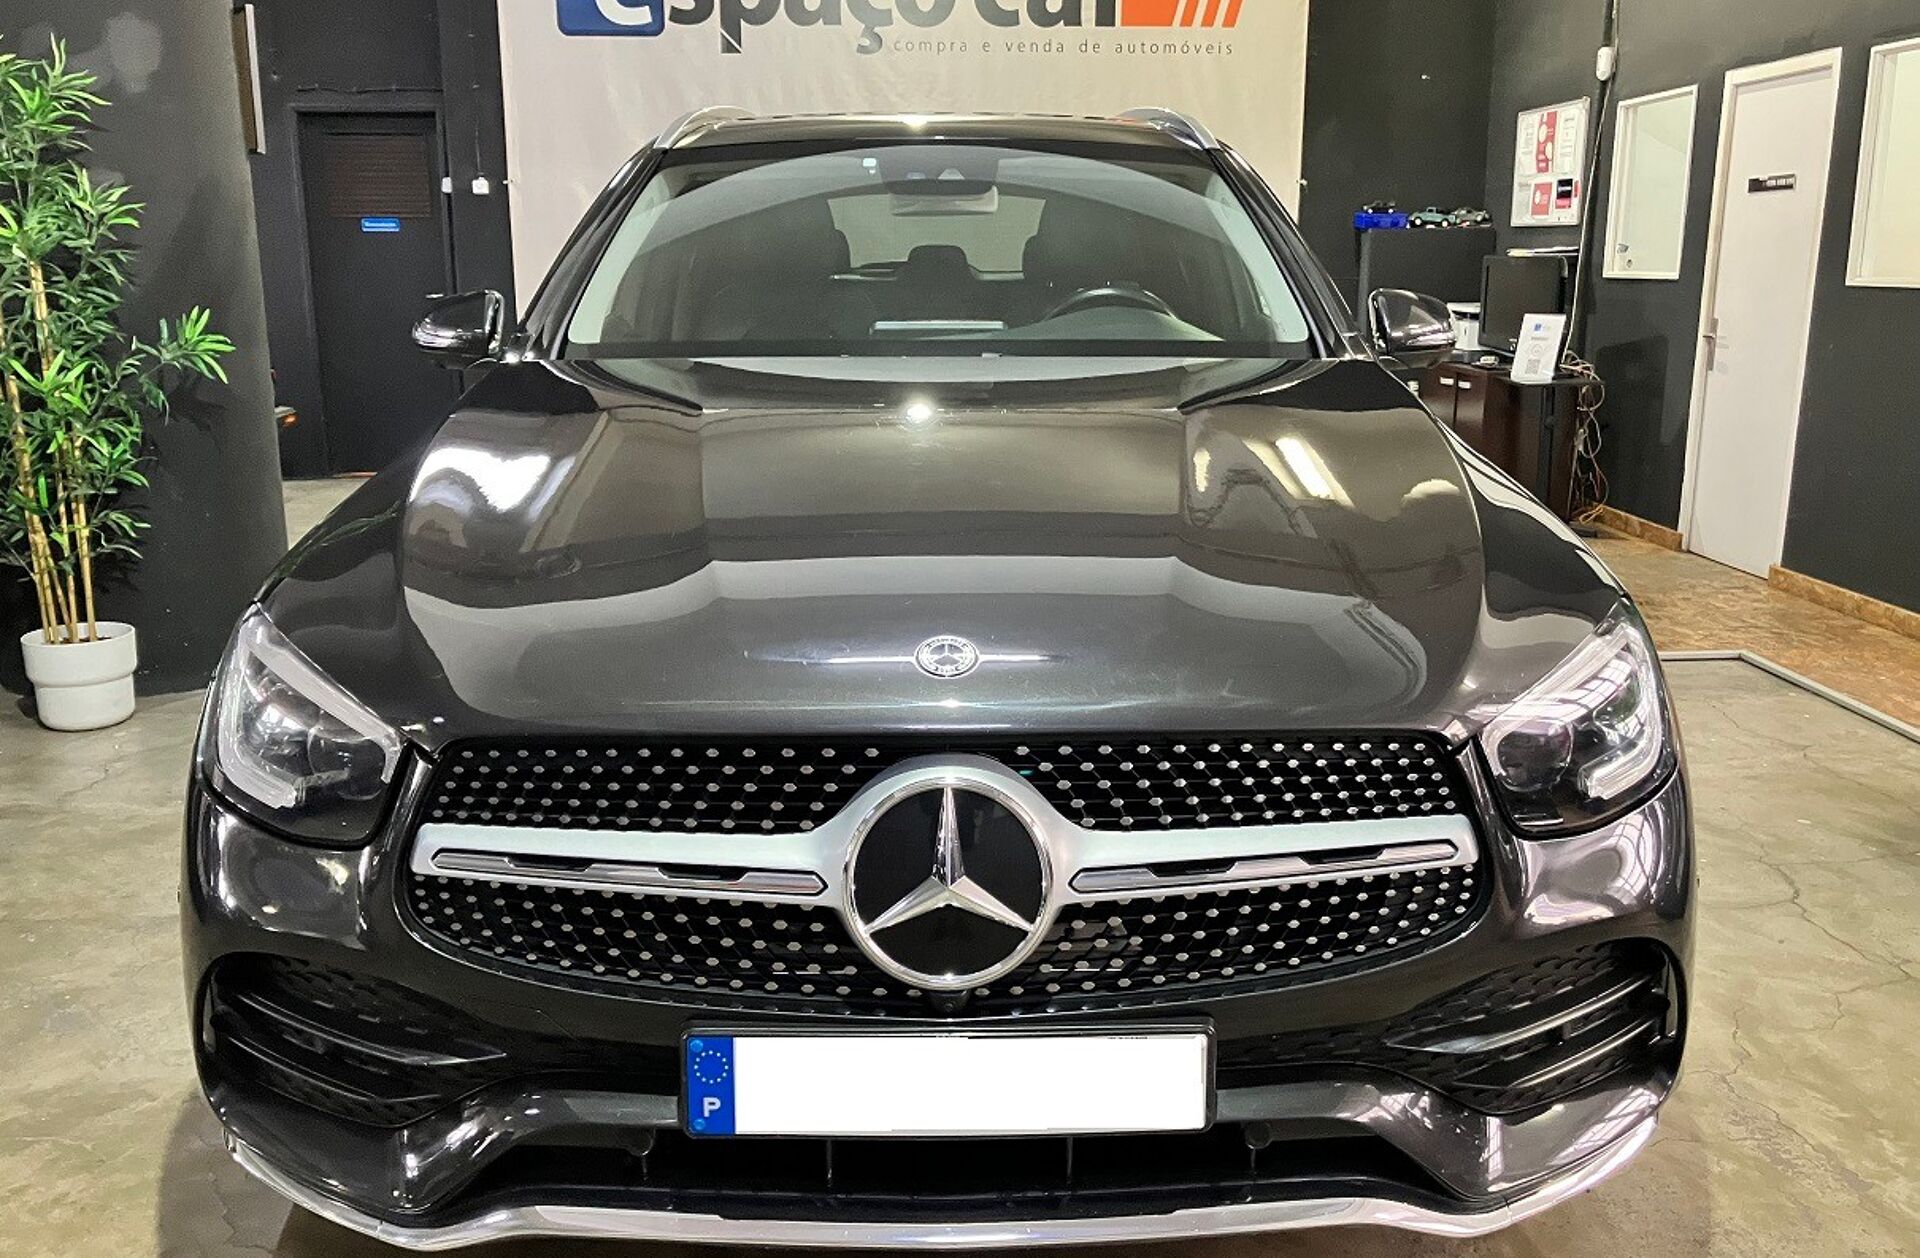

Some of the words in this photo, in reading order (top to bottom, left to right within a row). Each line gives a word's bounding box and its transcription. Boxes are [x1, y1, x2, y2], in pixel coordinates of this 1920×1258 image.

[893, 41, 968, 56] compra
[981, 41, 991, 53] e
[1005, 38, 1065, 53] venda
[1078, 39, 1101, 54] de
[1114, 40, 1233, 55] automóveis
[703, 1096, 721, 1117] P
